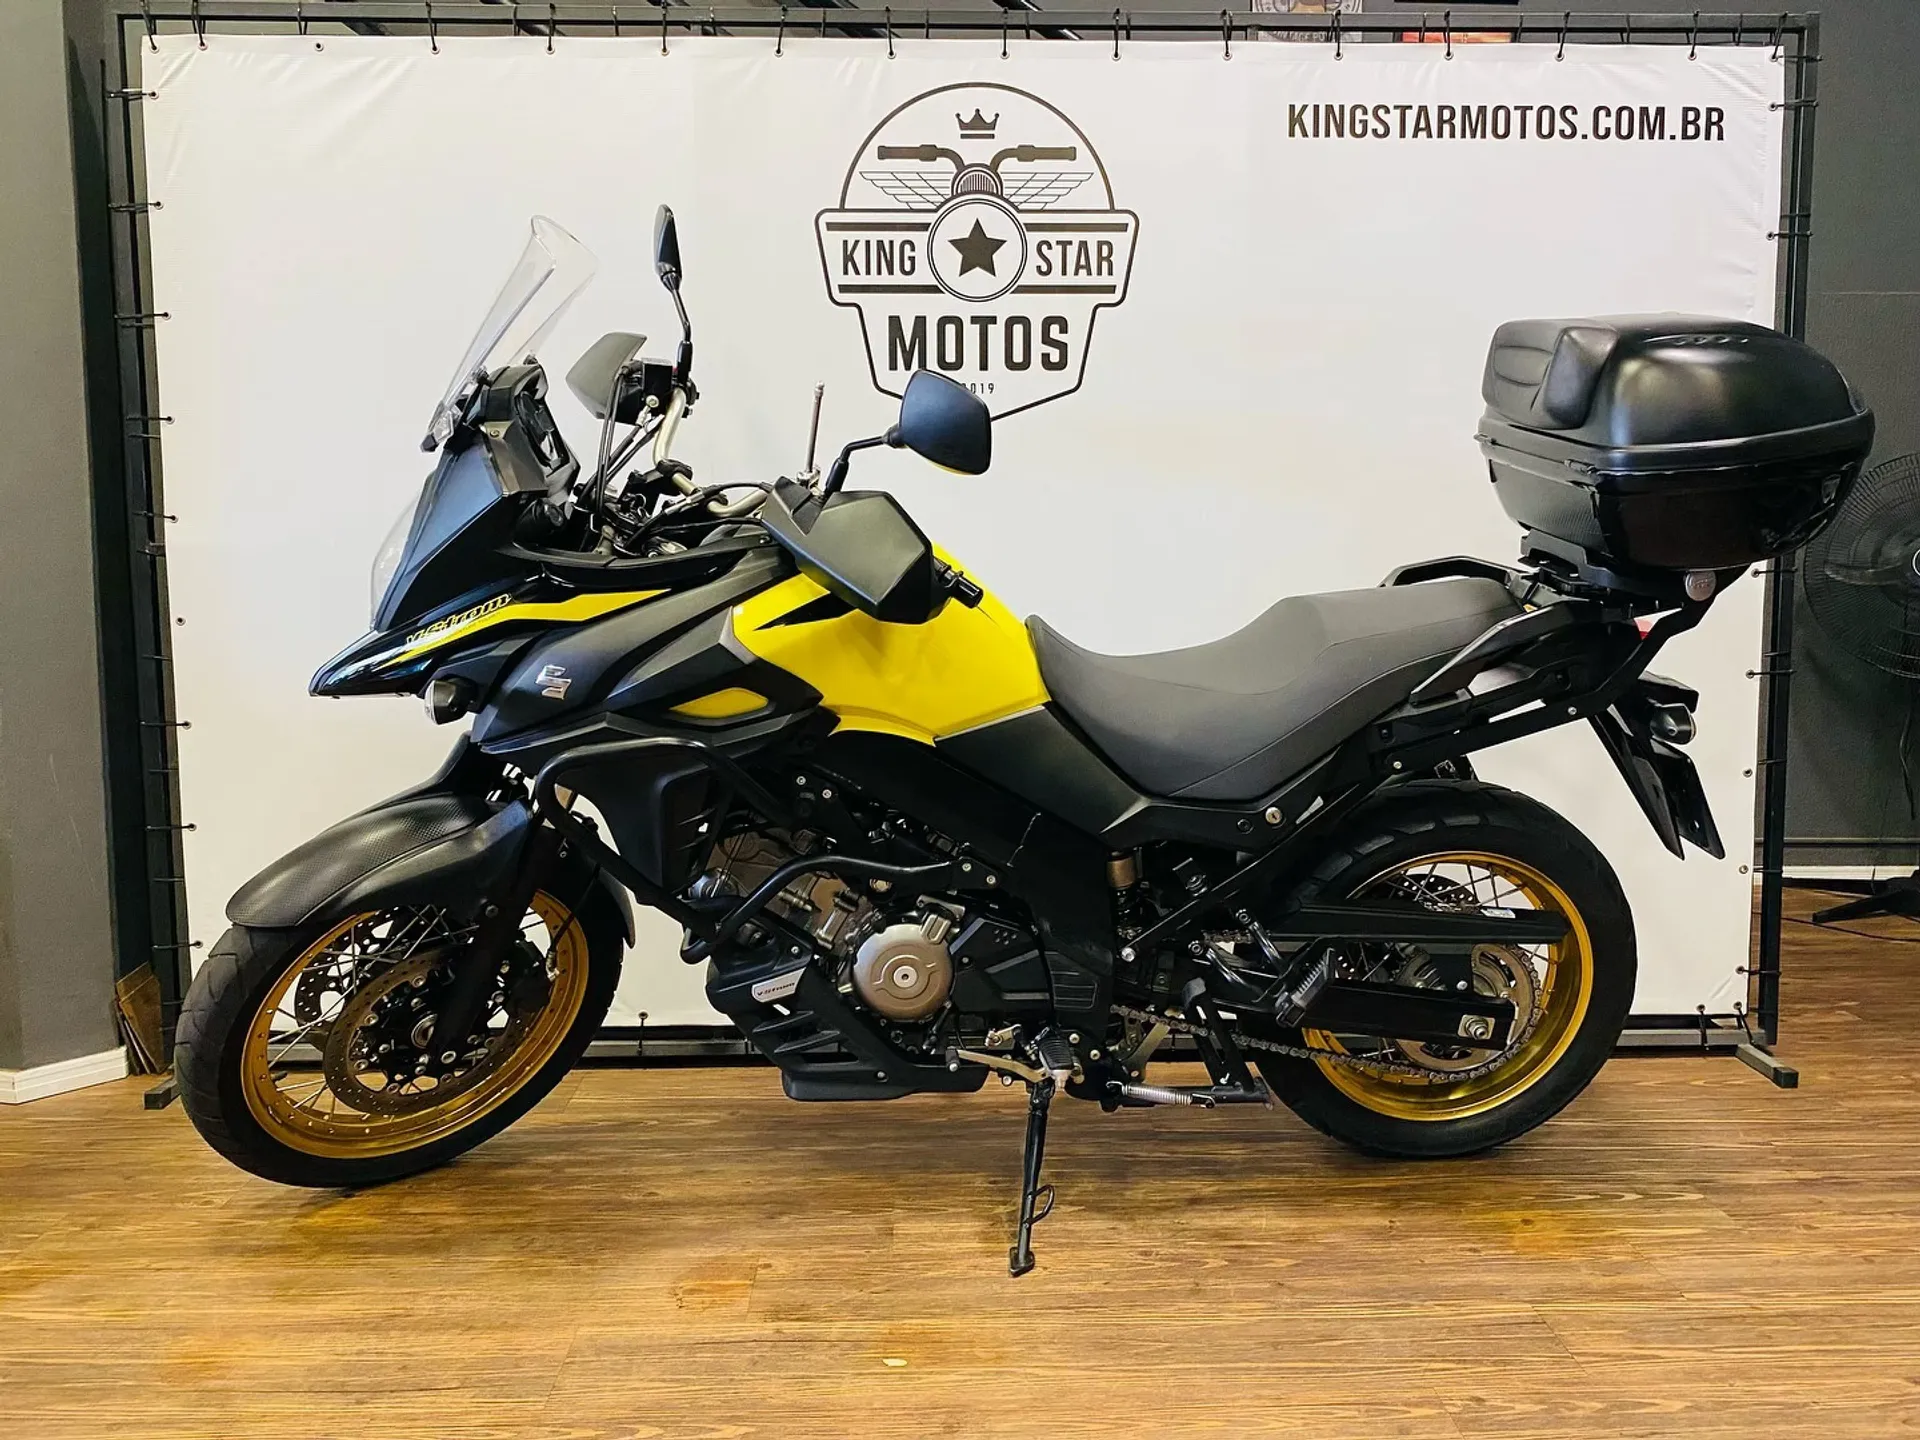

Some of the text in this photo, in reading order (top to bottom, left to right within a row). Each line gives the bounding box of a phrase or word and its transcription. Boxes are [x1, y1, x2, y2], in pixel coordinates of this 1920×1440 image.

[1288, 104, 1725, 141] KINGSTARMOTOS.COM.BR
[842, 239, 1114, 277] KING STAR
[888, 315, 1068, 371] MOTOS
